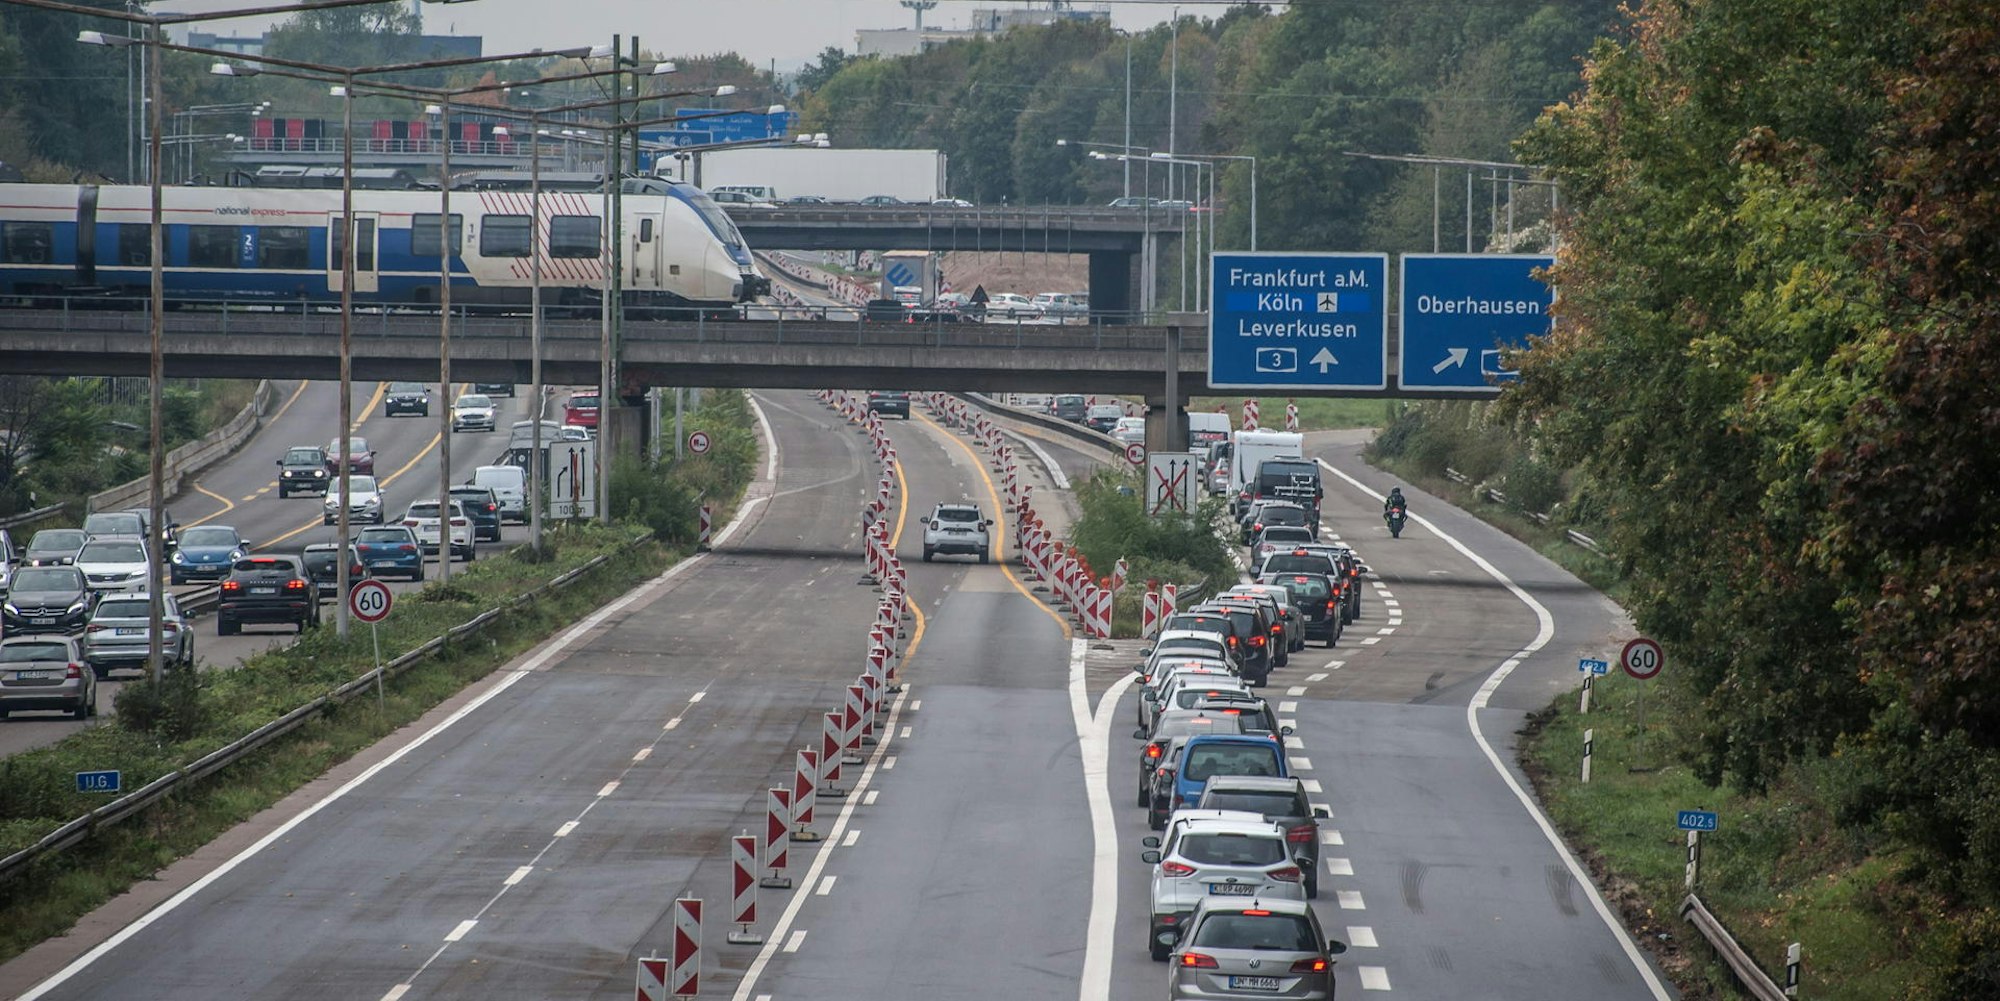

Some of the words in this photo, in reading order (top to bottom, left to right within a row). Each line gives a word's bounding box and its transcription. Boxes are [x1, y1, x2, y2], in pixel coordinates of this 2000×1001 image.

[214, 206, 250, 215] national
[251, 208, 286, 217] express
[245, 234, 252, 246] 2
[1230, 268, 1326, 287] Frankfurt
[1334, 269, 1369, 288] a.M.
[1258, 292, 1303, 311] Köln
[1417, 295, 1539, 314] Oberhausen
[1239, 318, 1357, 338] Leverkusen
[1272, 352, 1281, 367] 3
[559, 505, 574, 515] 100
[360, 591, 383, 611] 60
[1631, 649, 1655, 668] 60
[85, 775, 110, 788] U.G.
